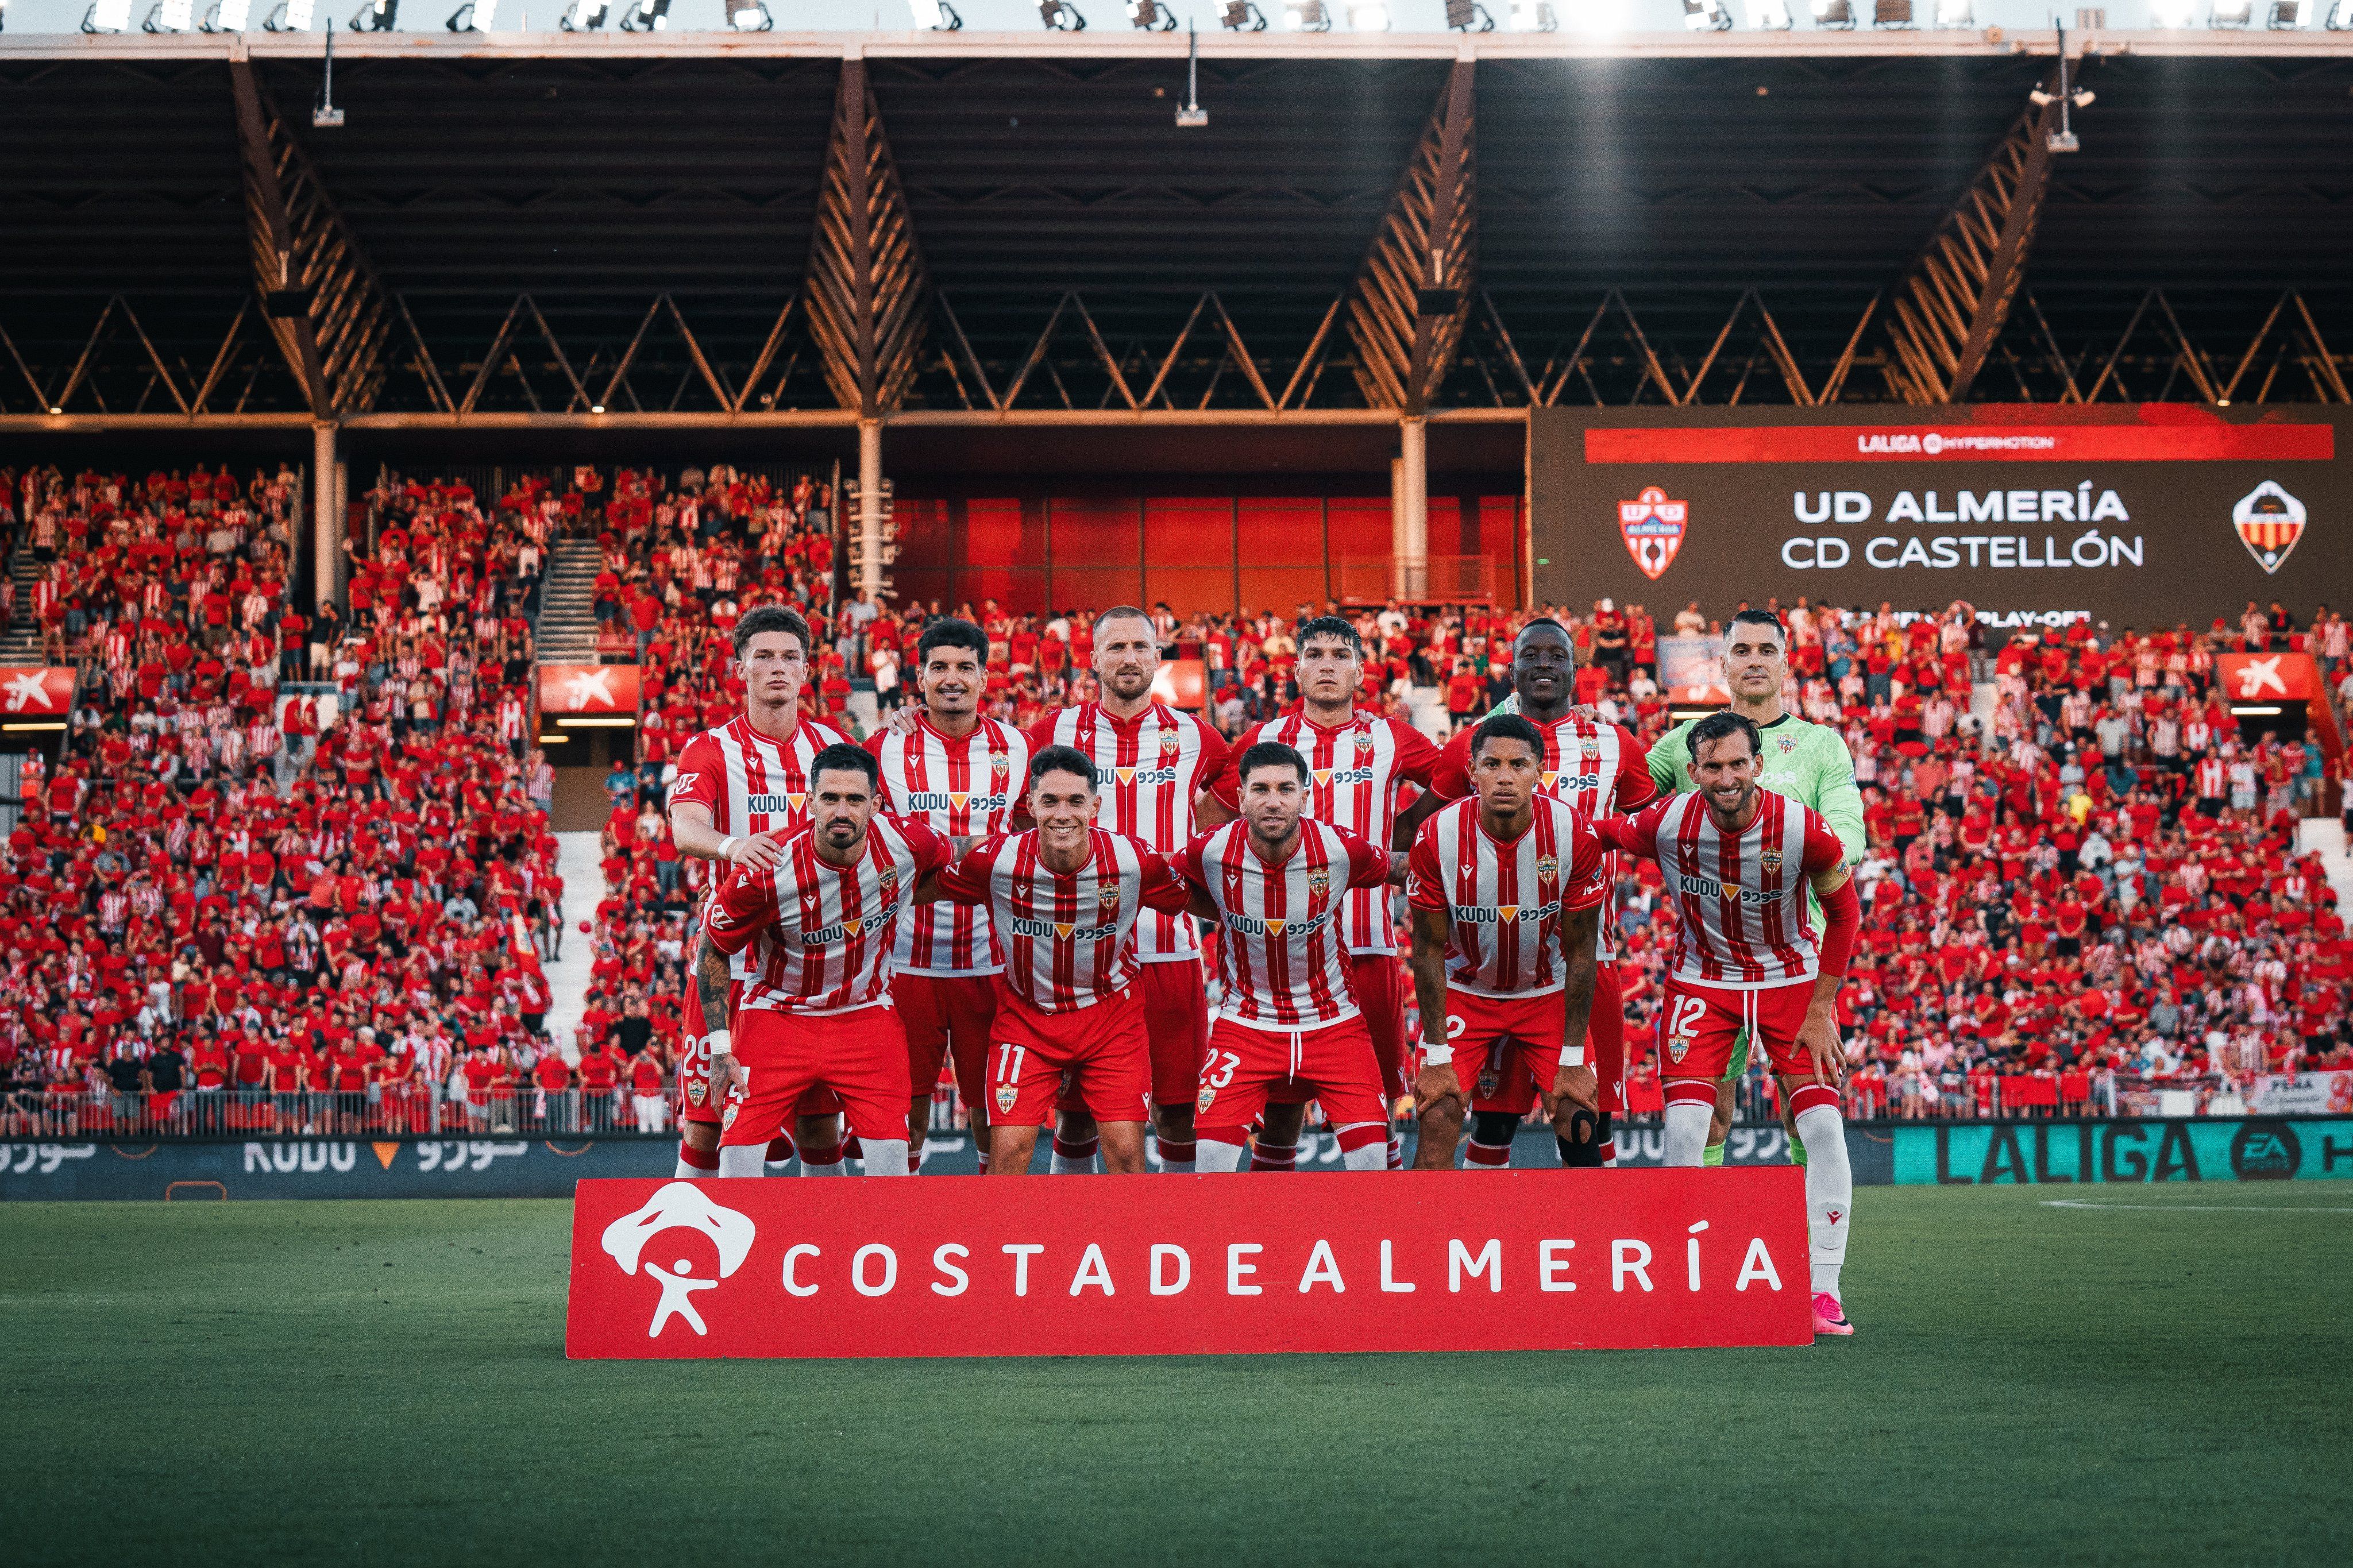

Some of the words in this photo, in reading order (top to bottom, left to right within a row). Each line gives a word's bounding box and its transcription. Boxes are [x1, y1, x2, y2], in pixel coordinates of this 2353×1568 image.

[1858, 435, 1921, 453] LALIGA
[1794, 491, 1872, 523] UD
[1885, 480, 2130, 522] ALMERÍA
[1781, 536, 1850, 569] CD
[1865, 529, 2143, 568] CASTELLÓN
[1097, 769, 1114, 783] DU
[748, 796, 786, 812] KUDU
[908, 794, 948, 810] KUDU
[1680, 876, 1720, 897] KUDU
[1225, 913, 1264, 935] KUDU
[1456, 905, 1497, 922] KUDU
[801, 926, 843, 945] KUDU
[1012, 919, 1054, 937] KUDU
[1669, 994, 1707, 1038] 12
[682, 1034, 711, 1077] 29
[997, 1044, 1025, 1084] 11
[1199, 1048, 1241, 1088] 23
[1936, 1124, 2203, 1184] LALIGA
[2243, 1133, 2288, 1158] EA
